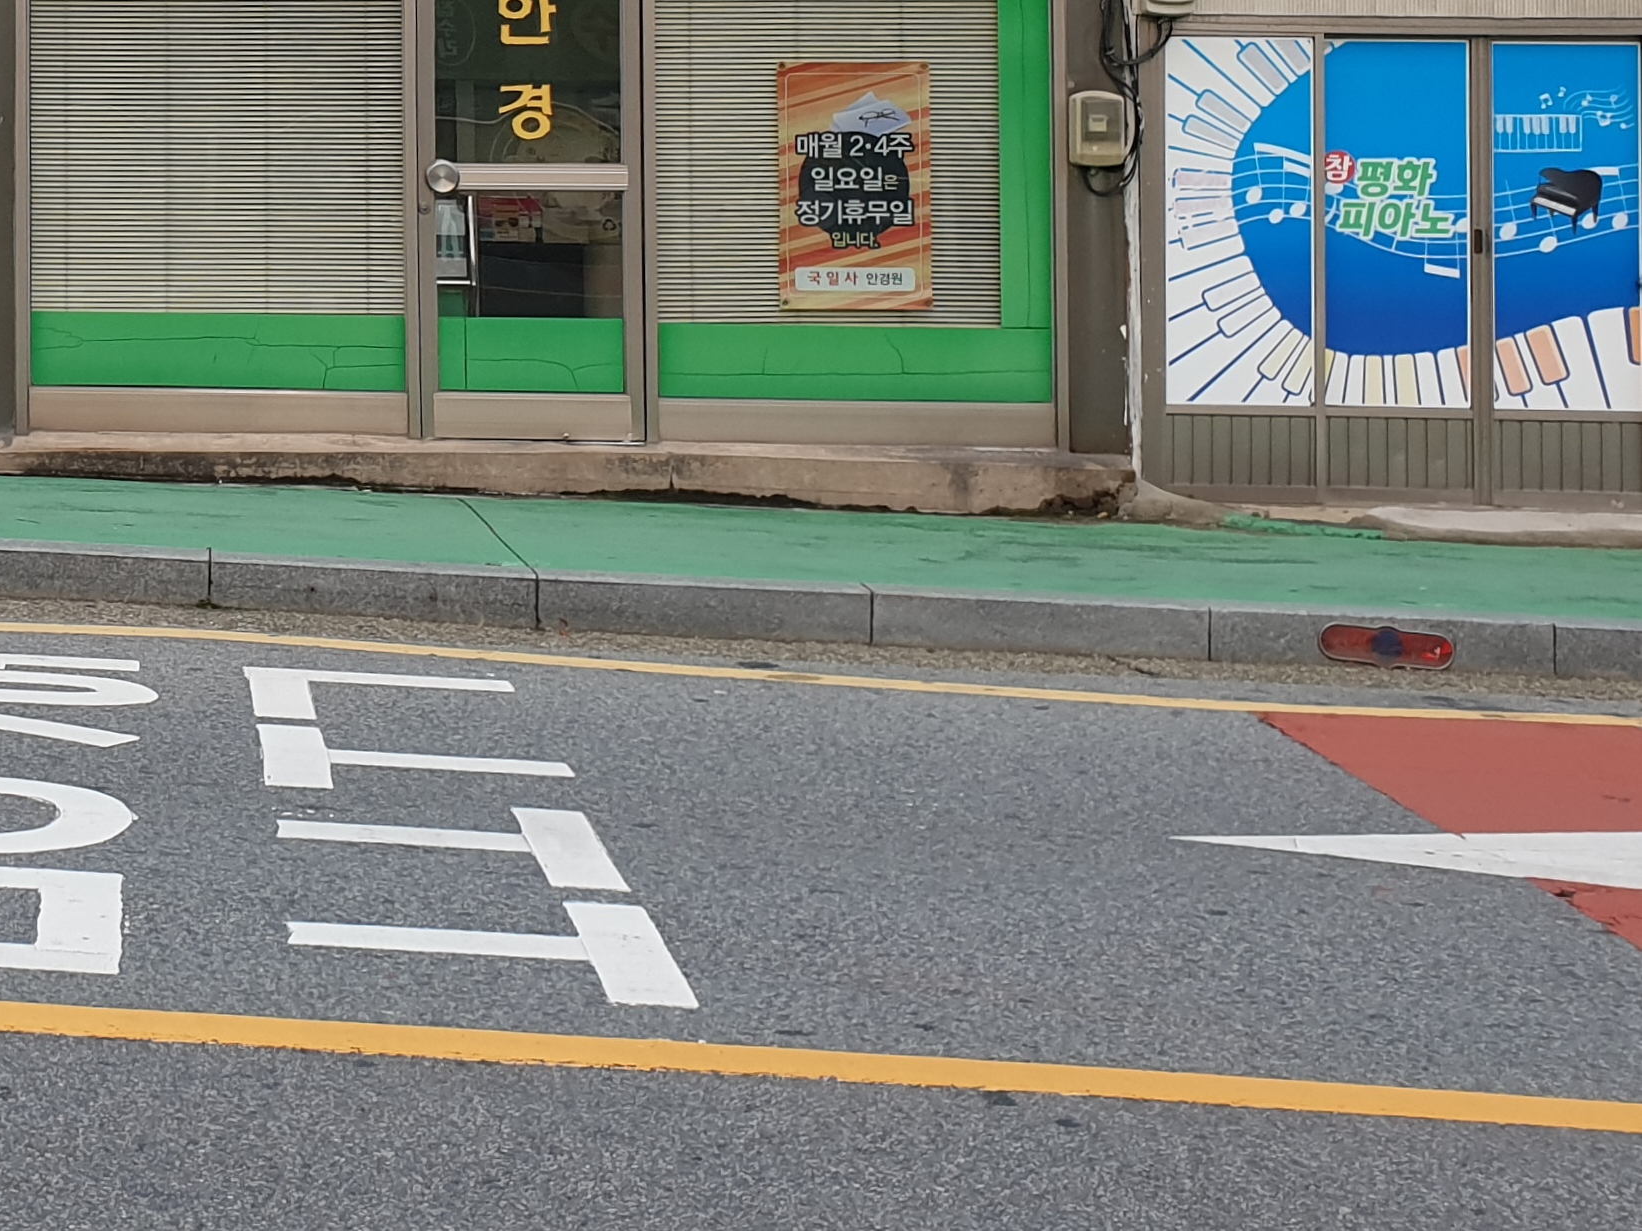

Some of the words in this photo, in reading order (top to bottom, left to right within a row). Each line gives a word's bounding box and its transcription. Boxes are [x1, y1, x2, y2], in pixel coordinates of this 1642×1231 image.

[796, 133, 843, 159] 매월
[811, 166, 899, 192] 일요일은
[1325, 154, 1353, 181] 참
[1357, 159, 1434, 198] 평화
[796, 199, 914, 226] 정기휴무일
[1338, 200, 1452, 238] 피아노
[832, 231, 879, 248] 입니다.
[865, 272, 903, 286] 안경원
